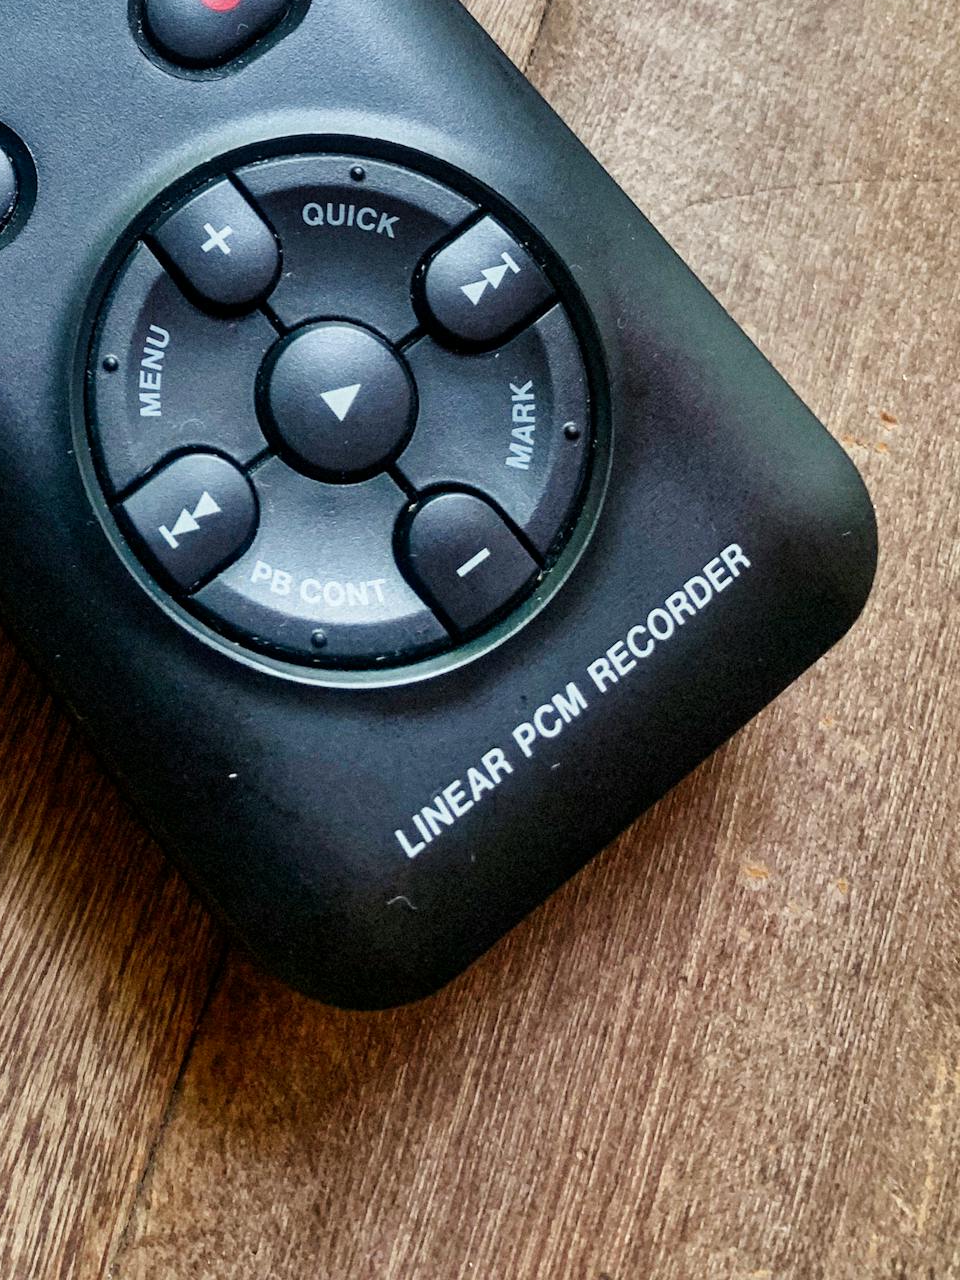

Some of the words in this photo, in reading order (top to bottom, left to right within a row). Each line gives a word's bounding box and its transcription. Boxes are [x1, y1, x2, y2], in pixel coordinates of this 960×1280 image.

[301, 202, 400, 239] QUICK
[139, 324, 171, 417] MENU
[505, 379, 534, 472] MARK
[250, 561, 293, 602] PB
[299, 577, 388, 608] CONT
[395, 747, 513, 858] LINEAR
[513, 682, 589, 757] PCM
[588, 544, 752, 694] RECORDER
